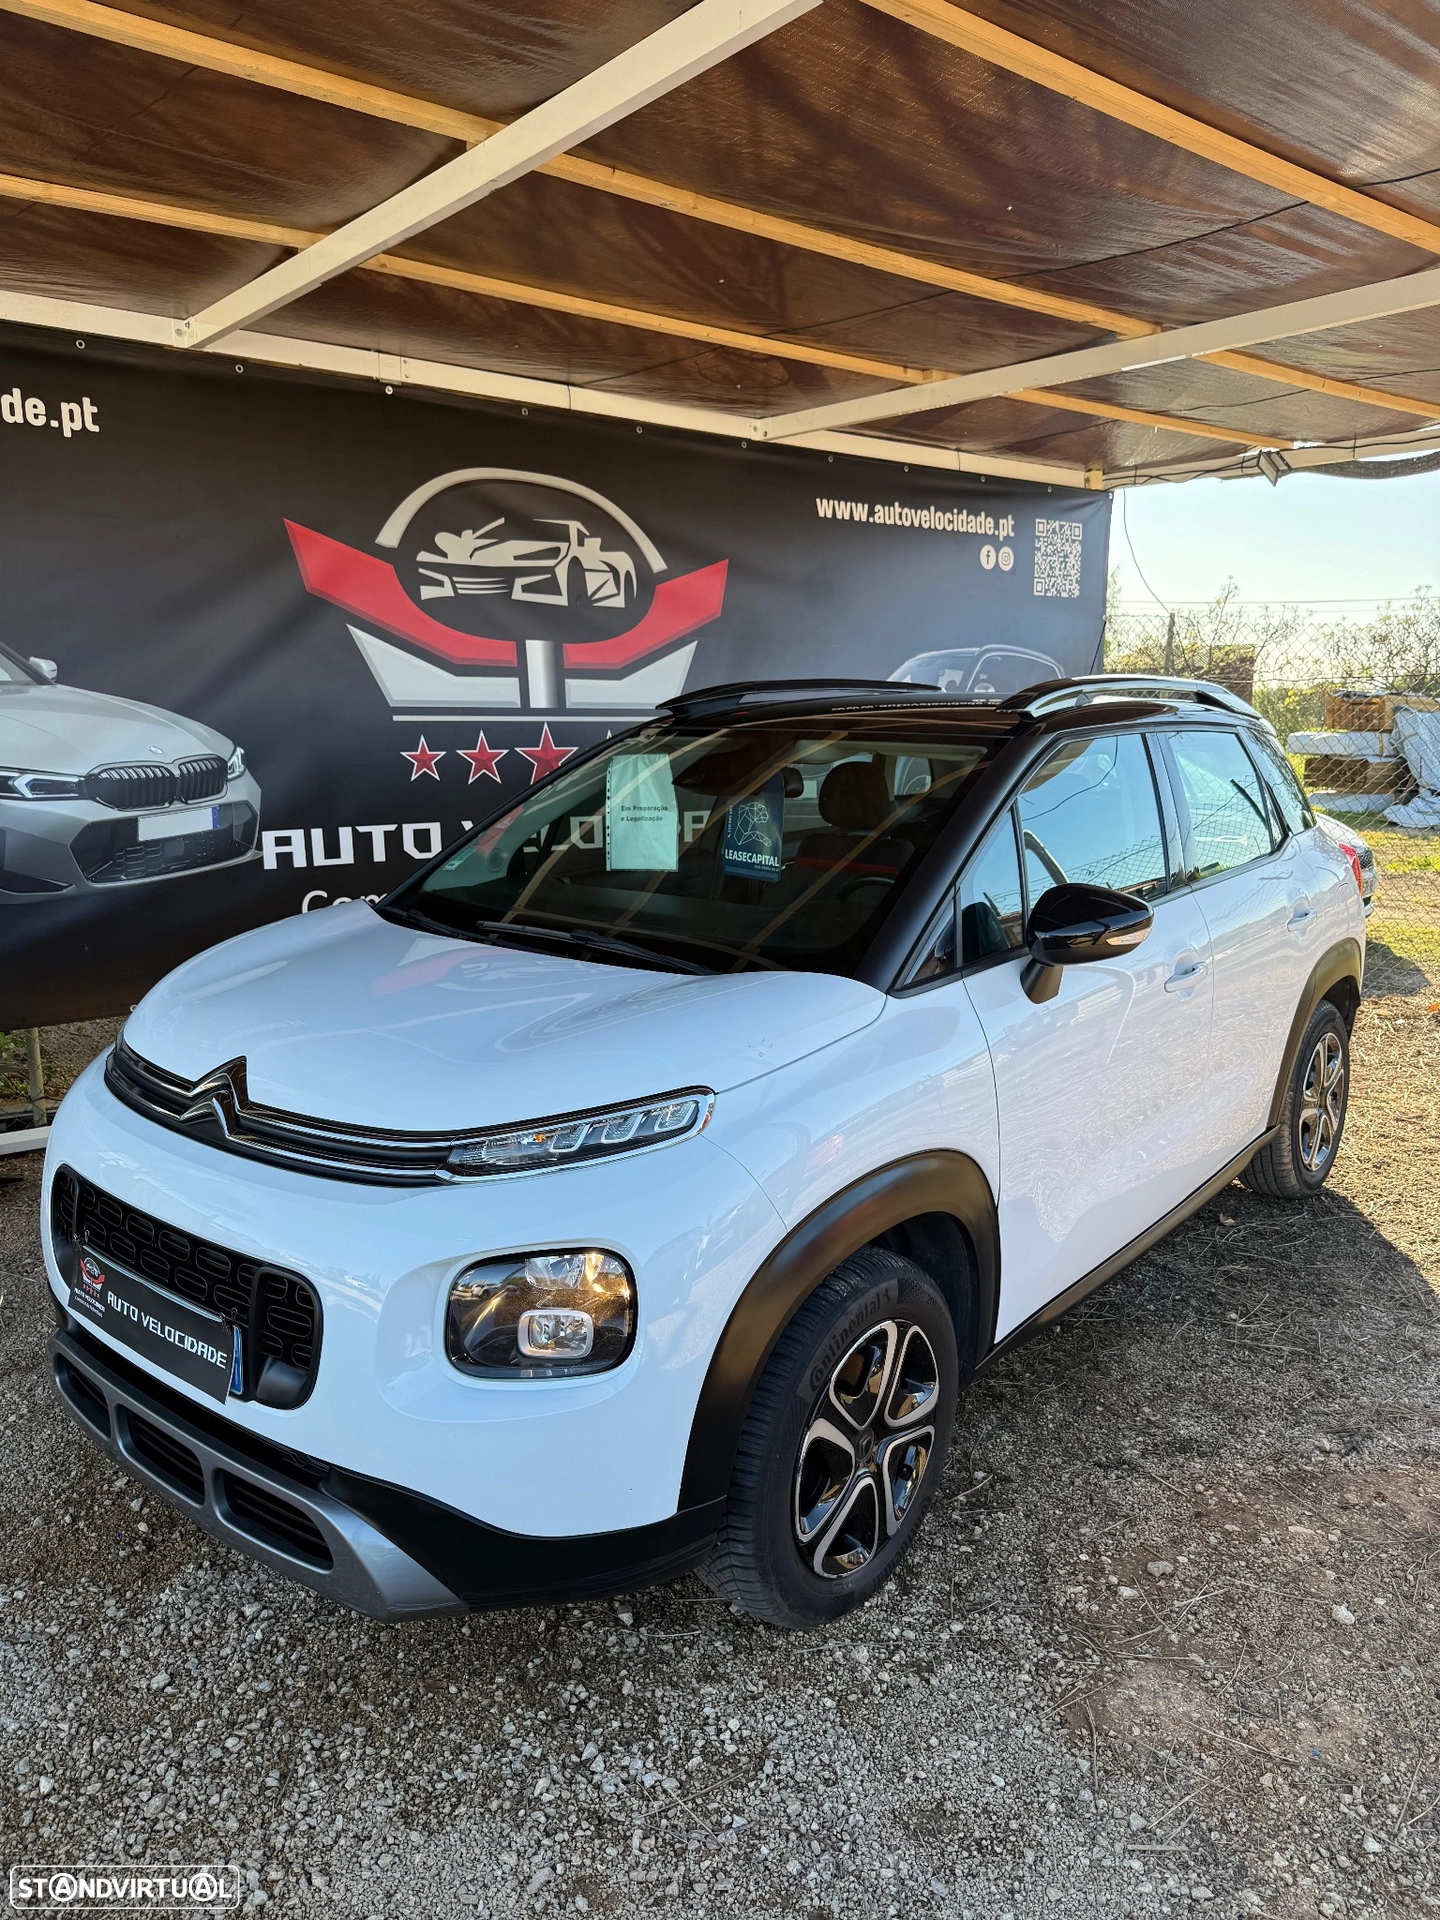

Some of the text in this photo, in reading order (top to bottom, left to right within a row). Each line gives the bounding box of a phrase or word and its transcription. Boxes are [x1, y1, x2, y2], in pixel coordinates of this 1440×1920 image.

[0, 387, 100, 438] de.pt
[815, 497, 1015, 542] www.autovelocidade.pt
[632, 804, 668, 812] Preparação
[261, 822, 442, 870] AUTO
[724, 848, 780, 867] LEASECAPITAL
[107, 1290, 139, 1322] AUTO
[141, 1311, 228, 1369] VELOCIDADE
[809, 1292, 882, 1392] Continental
